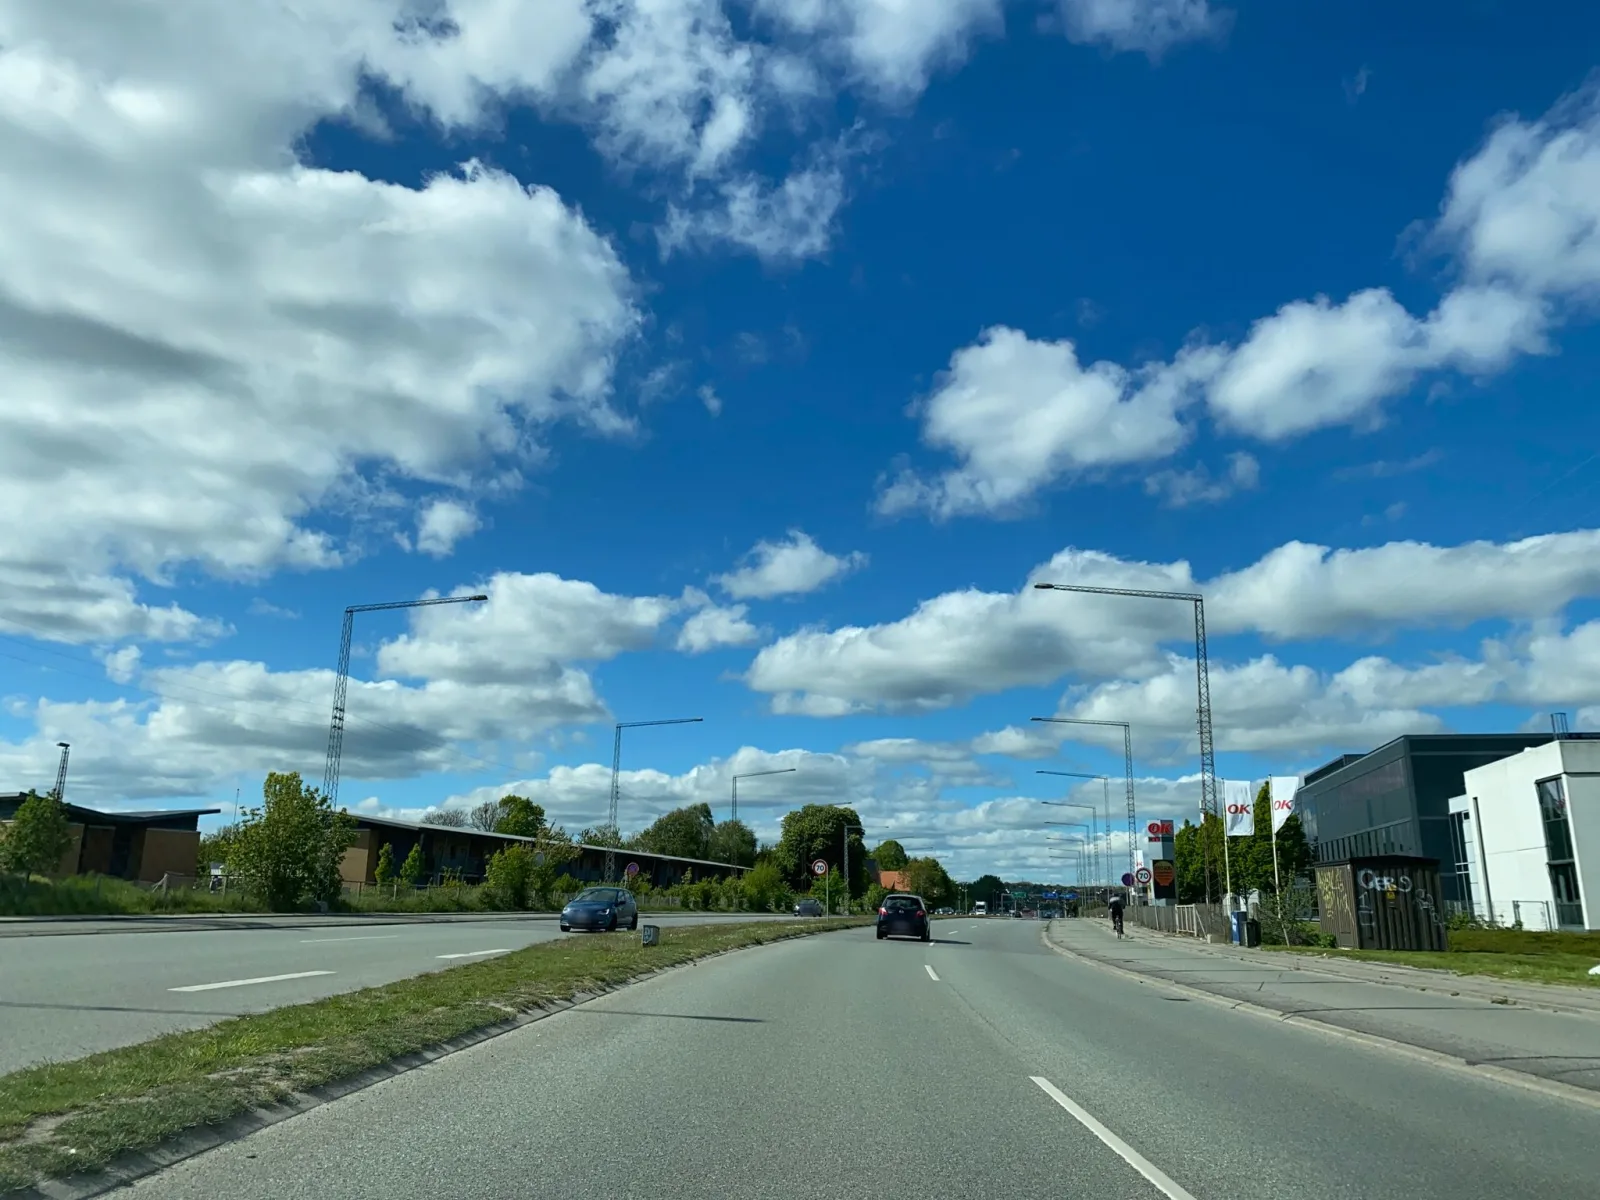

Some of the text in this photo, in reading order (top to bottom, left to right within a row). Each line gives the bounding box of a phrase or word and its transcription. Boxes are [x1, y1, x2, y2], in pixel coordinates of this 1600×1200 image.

[1227, 803, 1250, 815] OK
[1274, 799, 1294, 811] OK
[1147, 822, 1173, 835] OK
[816, 864, 825, 872] 70
[1138, 872, 1149, 880] 70
